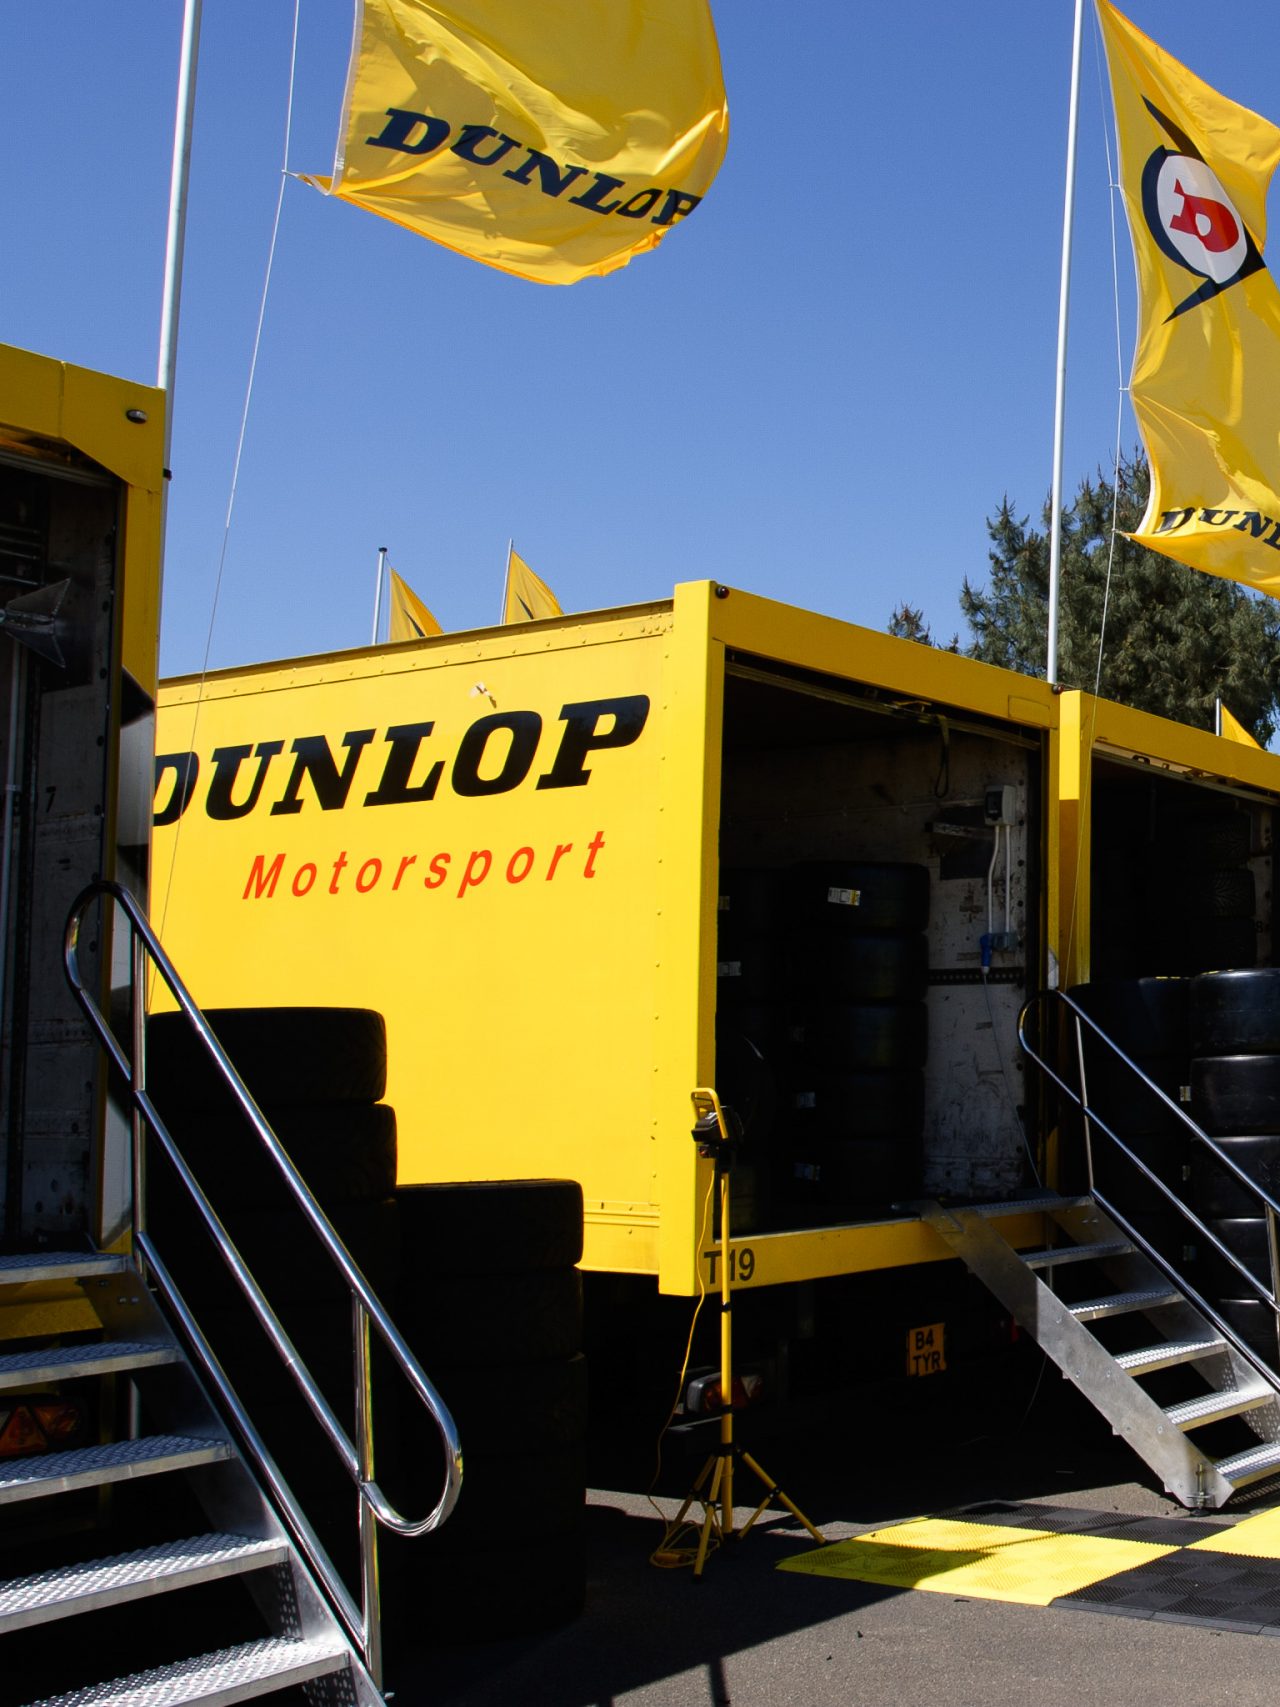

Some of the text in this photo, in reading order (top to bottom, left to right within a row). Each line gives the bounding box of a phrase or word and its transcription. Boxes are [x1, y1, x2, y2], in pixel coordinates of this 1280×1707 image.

[365, 107, 703, 226] DUNLOP
[151, 694, 651, 827] DUNLOP
[242, 830, 607, 901] Motorsport
[913, 1350, 942, 1374] TYR
[916, 1329, 934, 1350] B4
